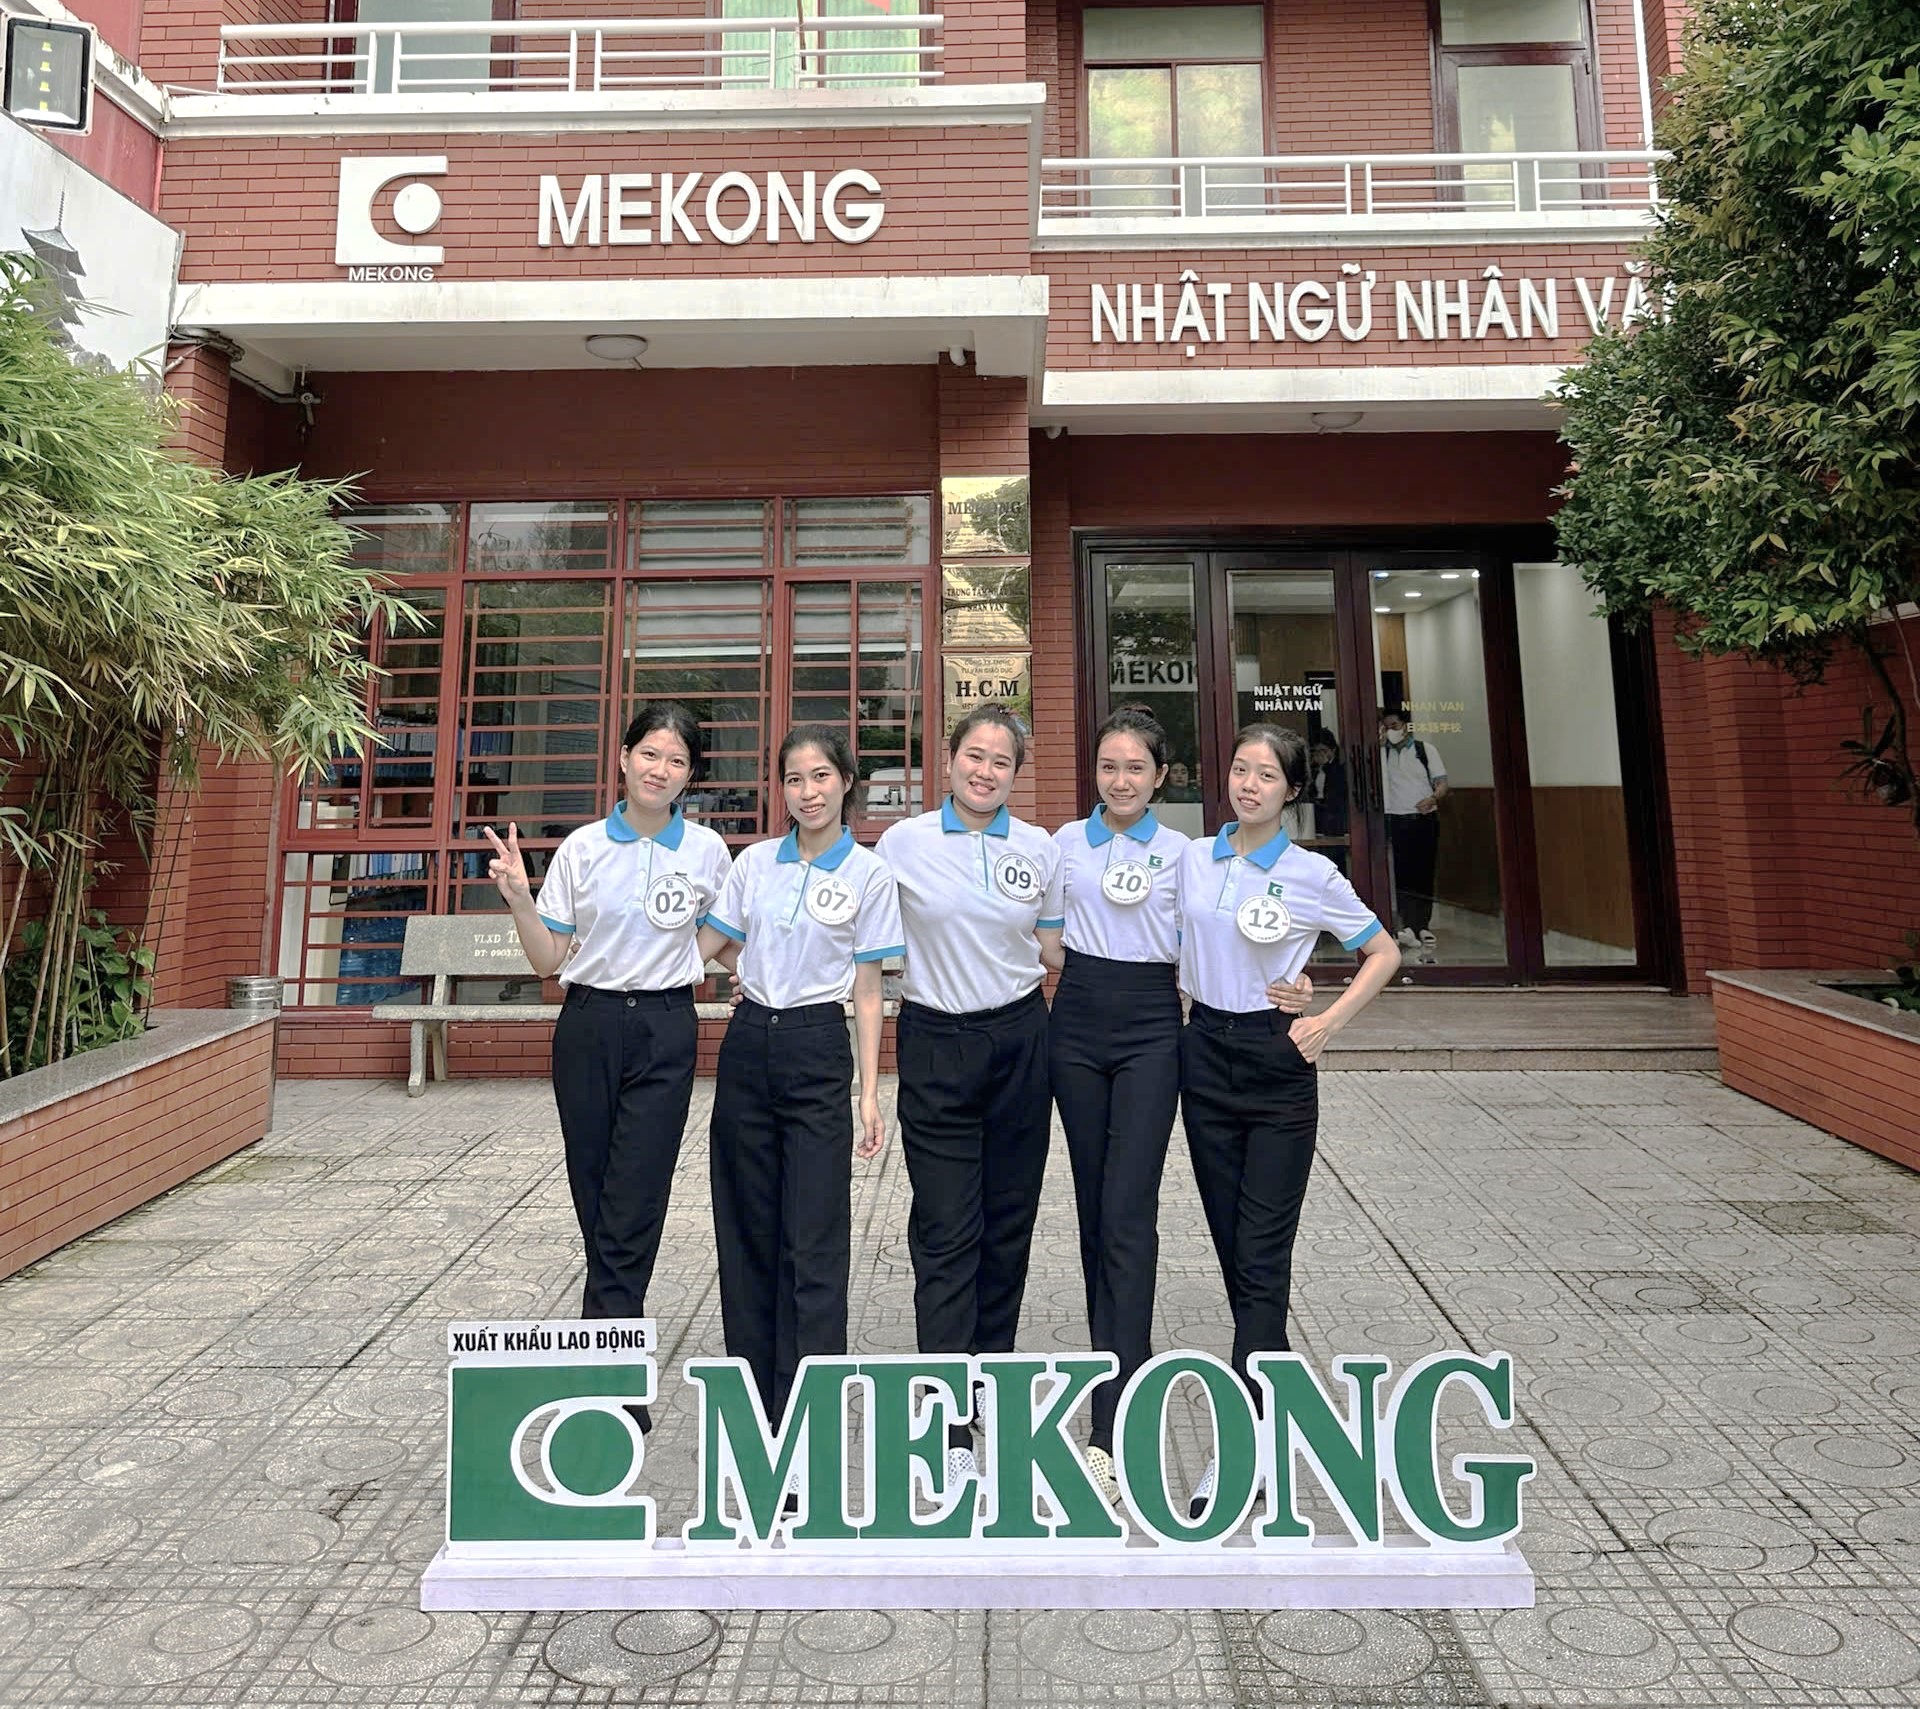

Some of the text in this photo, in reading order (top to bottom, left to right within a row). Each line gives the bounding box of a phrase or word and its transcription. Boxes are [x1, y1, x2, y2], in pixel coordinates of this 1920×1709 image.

[537, 168, 886, 248] MEKONG
[348, 265, 434, 282] MEKONG
[1091, 269, 1232, 358] NHẬT
[1249, 263, 1377, 342] NGỮ
[1395, 265, 1560, 341] NHÂN
[955, 680, 1019, 697] H.C.M
[1254, 683, 1323, 697] NHẬT NGỮ
[1254, 698, 1323, 711] NHÂN VĂN
[1004, 866, 1032, 889] 09
[1111, 871, 1142, 893] 10
[655, 890, 686, 914] 02
[816, 887, 849, 911] 07
[1247, 907, 1279, 931] 12
[474, 935, 501, 943] VLXD
[453, 1324, 646, 1353] XUẤT KHẨU LAO ĐỘNG
[685, 1355, 1535, 1544] MEKONG
